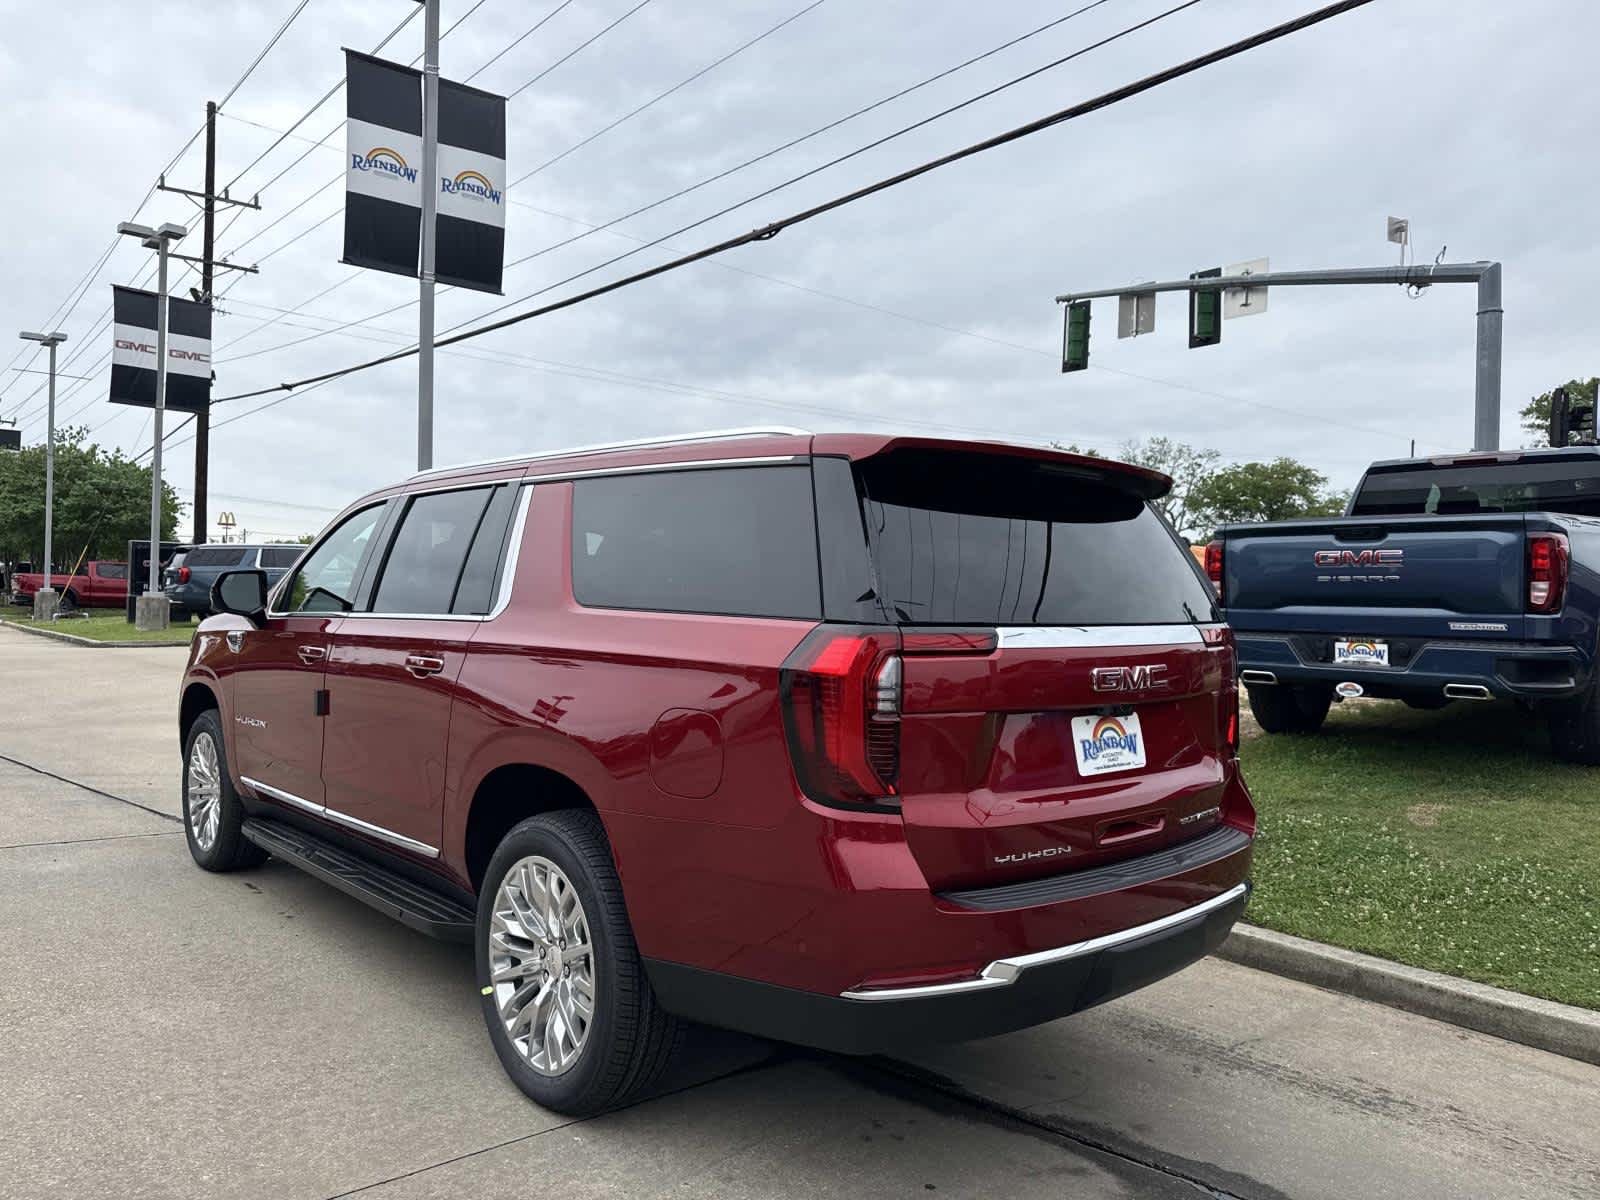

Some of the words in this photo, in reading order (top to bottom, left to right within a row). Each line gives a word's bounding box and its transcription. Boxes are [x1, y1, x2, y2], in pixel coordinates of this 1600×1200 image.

[351, 153, 418, 184] RAINBOW
[441, 176, 502, 205] RAINBOW
[115, 339, 157, 355] GMC
[168, 349, 210, 363] GMC
[1314, 549, 1404, 568] GMC
[1090, 663, 1168, 692] GMC
[1080, 733, 1138, 763] RAINBOW
[994, 845, 1072, 863] YUKON
